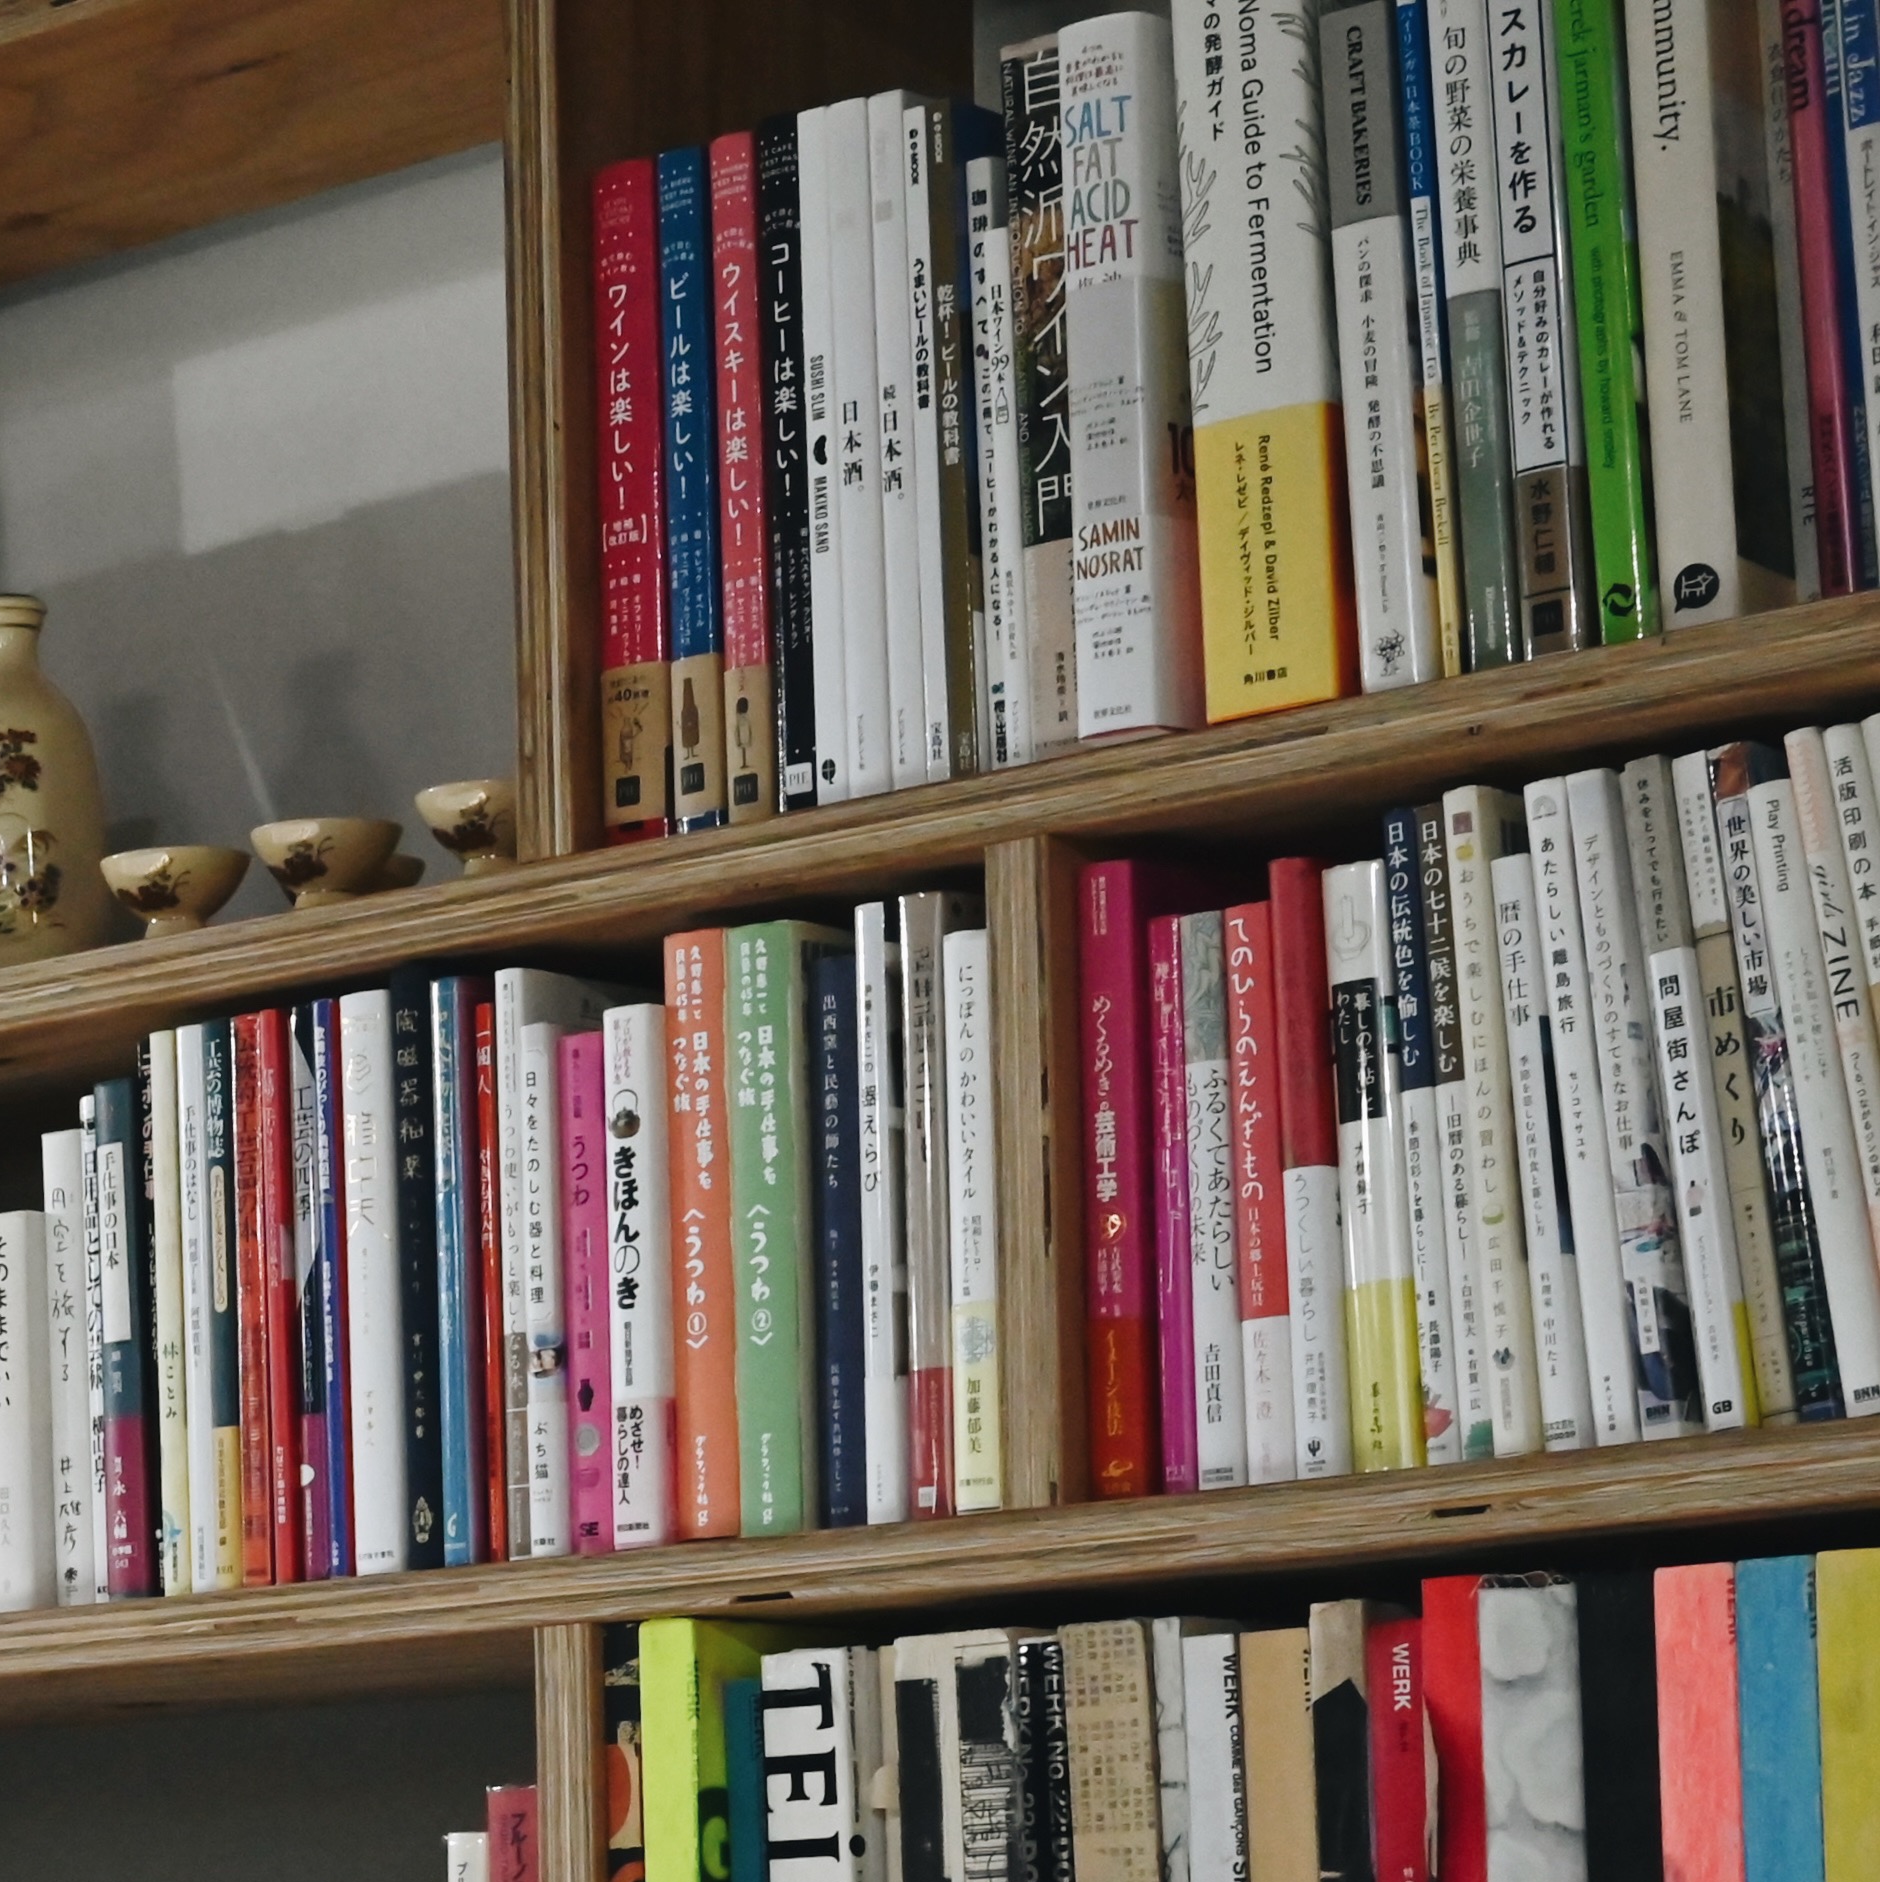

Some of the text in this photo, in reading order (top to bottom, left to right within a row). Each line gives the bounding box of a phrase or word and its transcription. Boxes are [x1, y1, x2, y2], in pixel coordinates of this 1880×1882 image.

[1065, 95, 1132, 149] SALT
[1241, 78, 1265, 155] Guide
[1346, 25, 1372, 207] CRAFT BAKERIES
[1443, 27, 1482, 269] 旬の野菜の栄養事典
[1843, 14, 1876, 122] in Jazz
[1070, 178, 1131, 231] ACID
[1073, 138, 1123, 187] FAT
[1246, 162, 1267, 190] to
[1573, 151, 1600, 229] garden
[1066, 219, 1139, 272] HEAT
[1248, 197, 1274, 374] Fermentation
[608, 284, 634, 510] ワインは楽しい！
[670, 272, 693, 499] ビールは楽しい！
[722, 262, 750, 546] ウイスキーは楽しい！
[771, 243, 799, 497] コーヒーは楽しい！
[913, 258, 930, 410] うまいビールの教科書
[1533, 269, 1556, 450] 自分好みのカレーが作れる
[1670, 250, 1693, 424] EMMA TOM LANE
[810, 355, 830, 553] SUSHI SLIM MAKIKO SANO
[842, 400, 865, 492] 日本酒。
[1076, 547, 1144, 581] NOSRAT
[1078, 517, 1140, 551] SAMIN
[1258, 434, 1281, 640] René Redzepi David Zilber
[1725, 816, 1768, 997] 世界の美しい市場
[1766, 799, 1789, 893] Play Printing
[1833, 756, 1876, 901] 活版印刷の本
[1421, 820, 1458, 1073] 日本の七十二候を楽しむ
[1500, 899, 1530, 1027] 暦の手仕事
[1541, 837, 1576, 1034] あたらしい離島旅行
[1822, 928, 1860, 1022] ZINE
[692, 1031, 714, 1191] 日本の手仕事を
[757, 1025, 779, 1186] 日本の手仕事を
[1229, 918, 1264, 1201] てのひらのえんぎもの
[1659, 975, 1701, 1155] 問屋街さんぽ
[1707, 986, 1745, 1147] 市めくり
[102, 1152, 120, 1270] 手仕事の日本
[524, 1072, 544, 1305] 日々をたのしむ器と料理
[612, 1144, 640, 1310] きほんのき
[1203, 1068, 1234, 1291] ふるくてあたらしい
[1295, 1174, 1318, 1342] うつくしい暮らし
[163, 1341, 180, 1419] 林ことみ
[1203, 1343, 1223, 1424] 吉田貞信
[1712, 1400, 1733, 1415] GB
[1223, 1653, 1241, 1718] WERK
[1392, 1643, 1411, 1711] WERK
